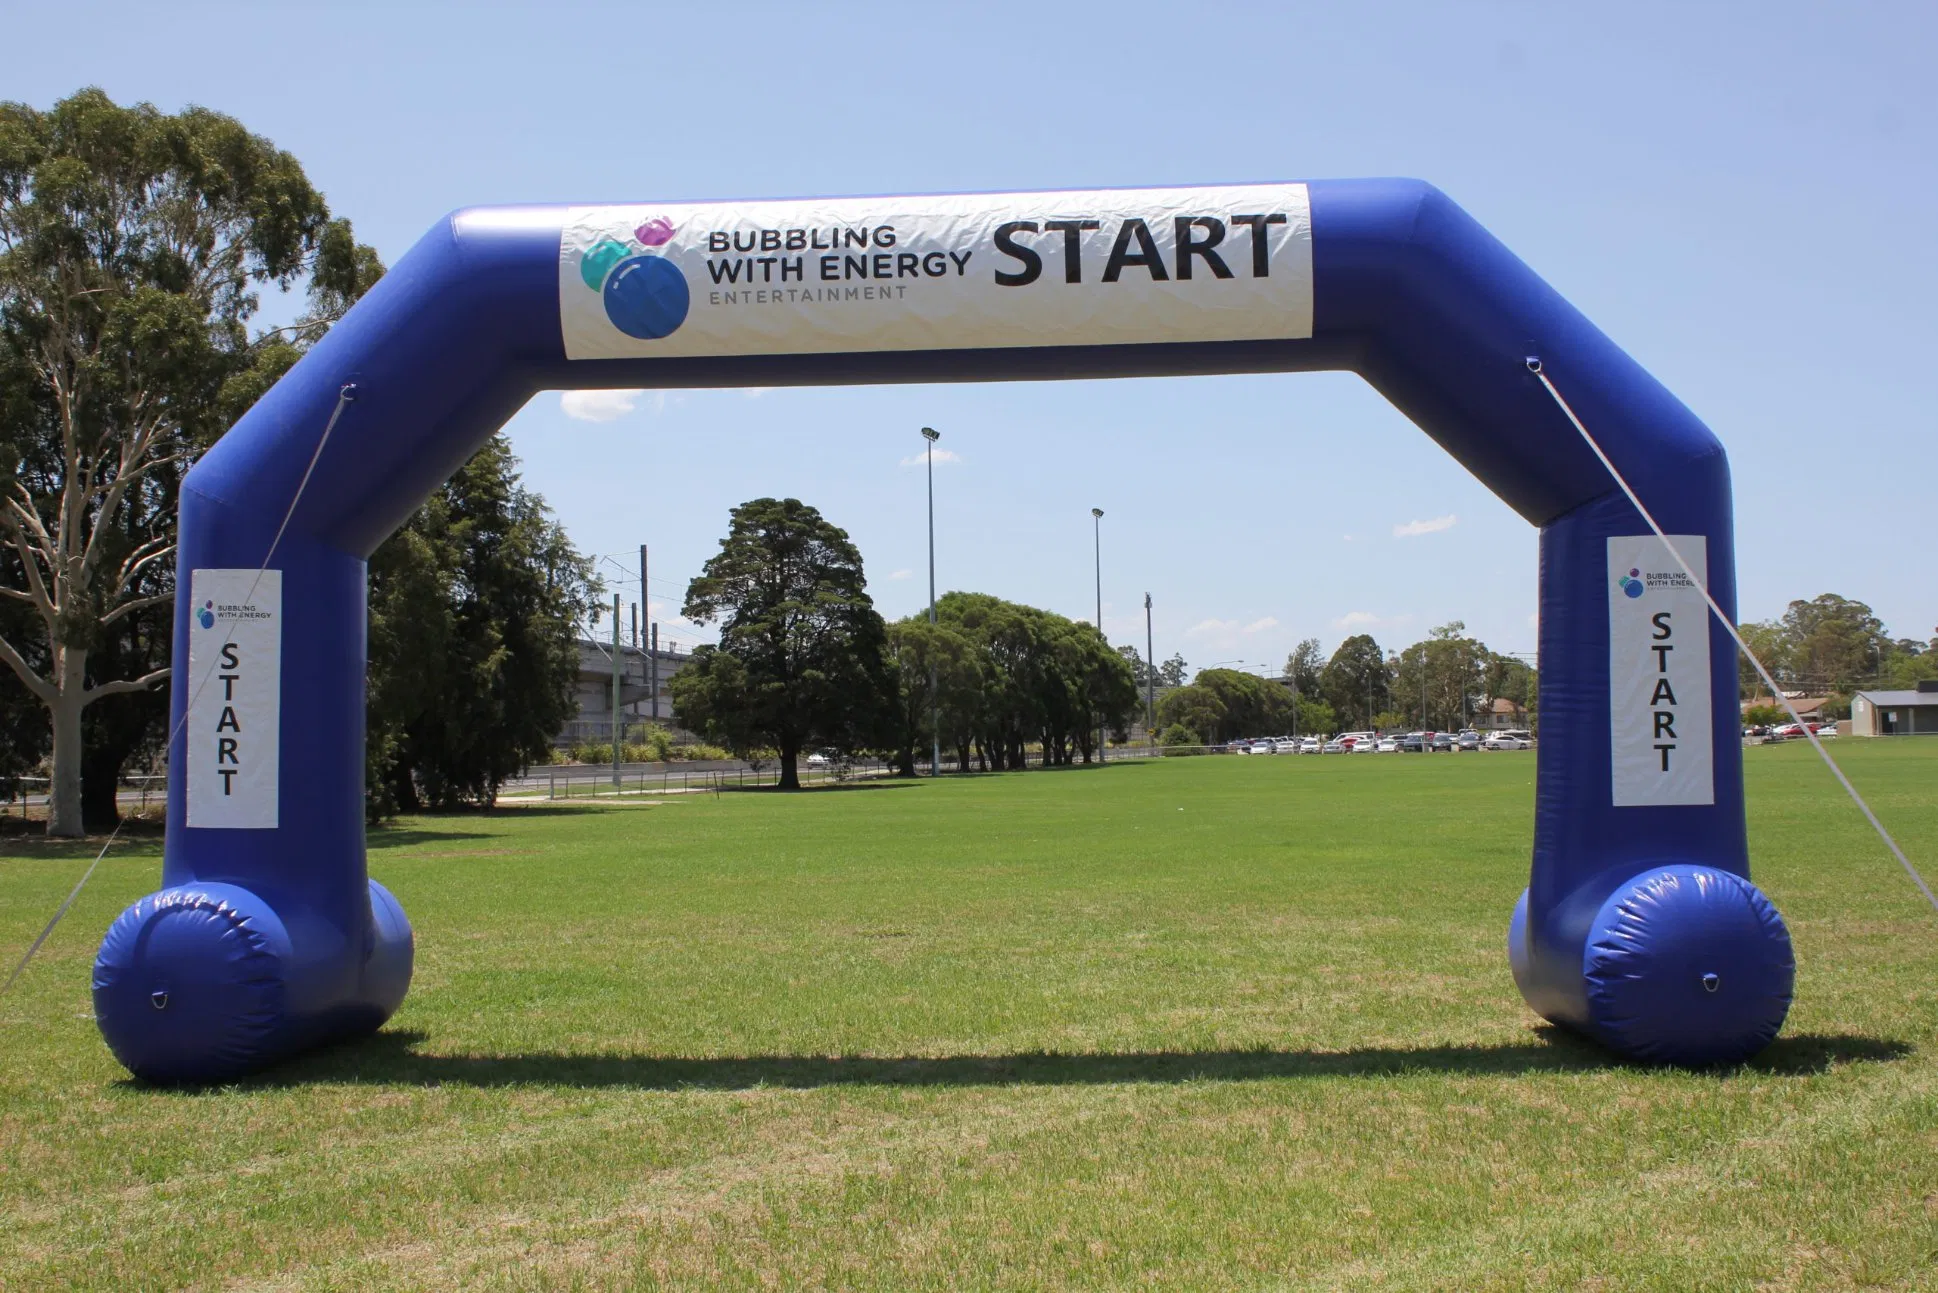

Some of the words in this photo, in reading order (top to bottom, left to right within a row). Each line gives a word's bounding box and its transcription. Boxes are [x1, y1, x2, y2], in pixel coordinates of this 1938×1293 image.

[708, 225, 897, 253] BUBBLING
[993, 213, 1287, 287] START
[707, 256, 803, 285] WITH
[820, 250, 973, 280] ENERGY
[709, 285, 908, 306] ENTERTAINMENT
[1646, 572, 1687, 580] BUBBLING
[1671, 579, 1696, 587] ENER
[1650, 612, 1677, 772] START
[216, 642, 241, 796] START
